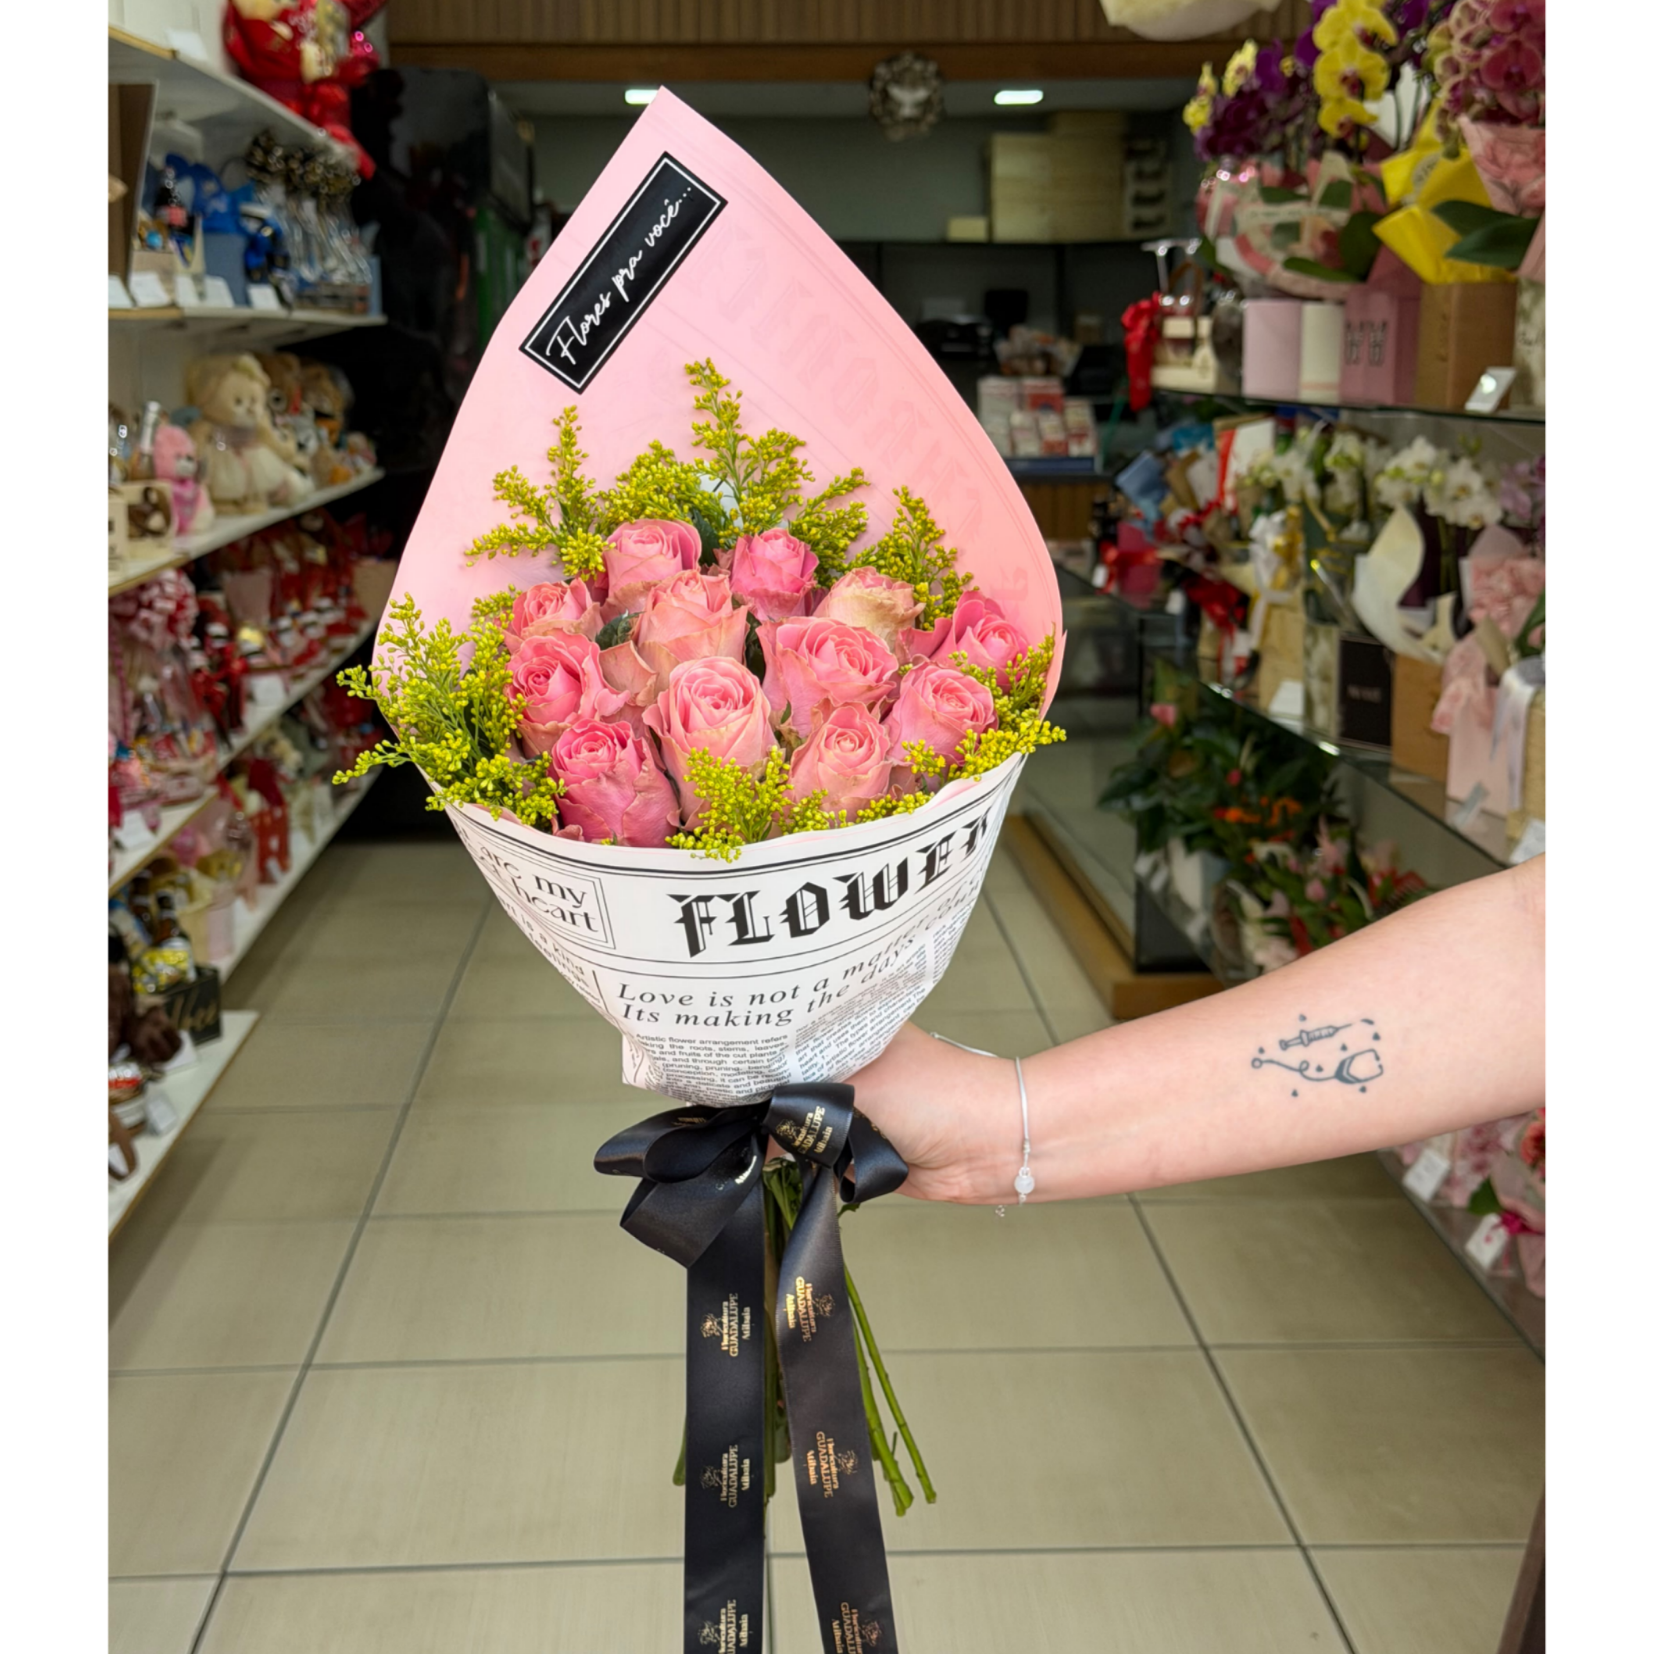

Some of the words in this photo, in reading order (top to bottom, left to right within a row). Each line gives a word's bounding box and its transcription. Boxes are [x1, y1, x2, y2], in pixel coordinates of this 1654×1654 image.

[545, 291, 611, 365] Flores
[611, 249, 643, 303] pra
[511, 877, 599, 933] heart
[533, 874, 587, 909] my
[618, 982, 693, 1006] Love
[709, 991, 734, 1008] is
[749, 985, 801, 1006] not
[813, 977, 829, 992] a
[842, 914, 929, 980] matter
[623, 1003, 660, 1023] Its
[675, 1009, 794, 1027] making
[807, 984, 850, 1014] the
[861, 934, 916, 985] days
[728, 1292, 738, 1358] GUADALUPE
[795, 1276, 812, 1342] GUADALUPE
[728, 1444, 738, 1509] GUADALUPE
[816, 1430, 833, 1499] GUADALUPE
